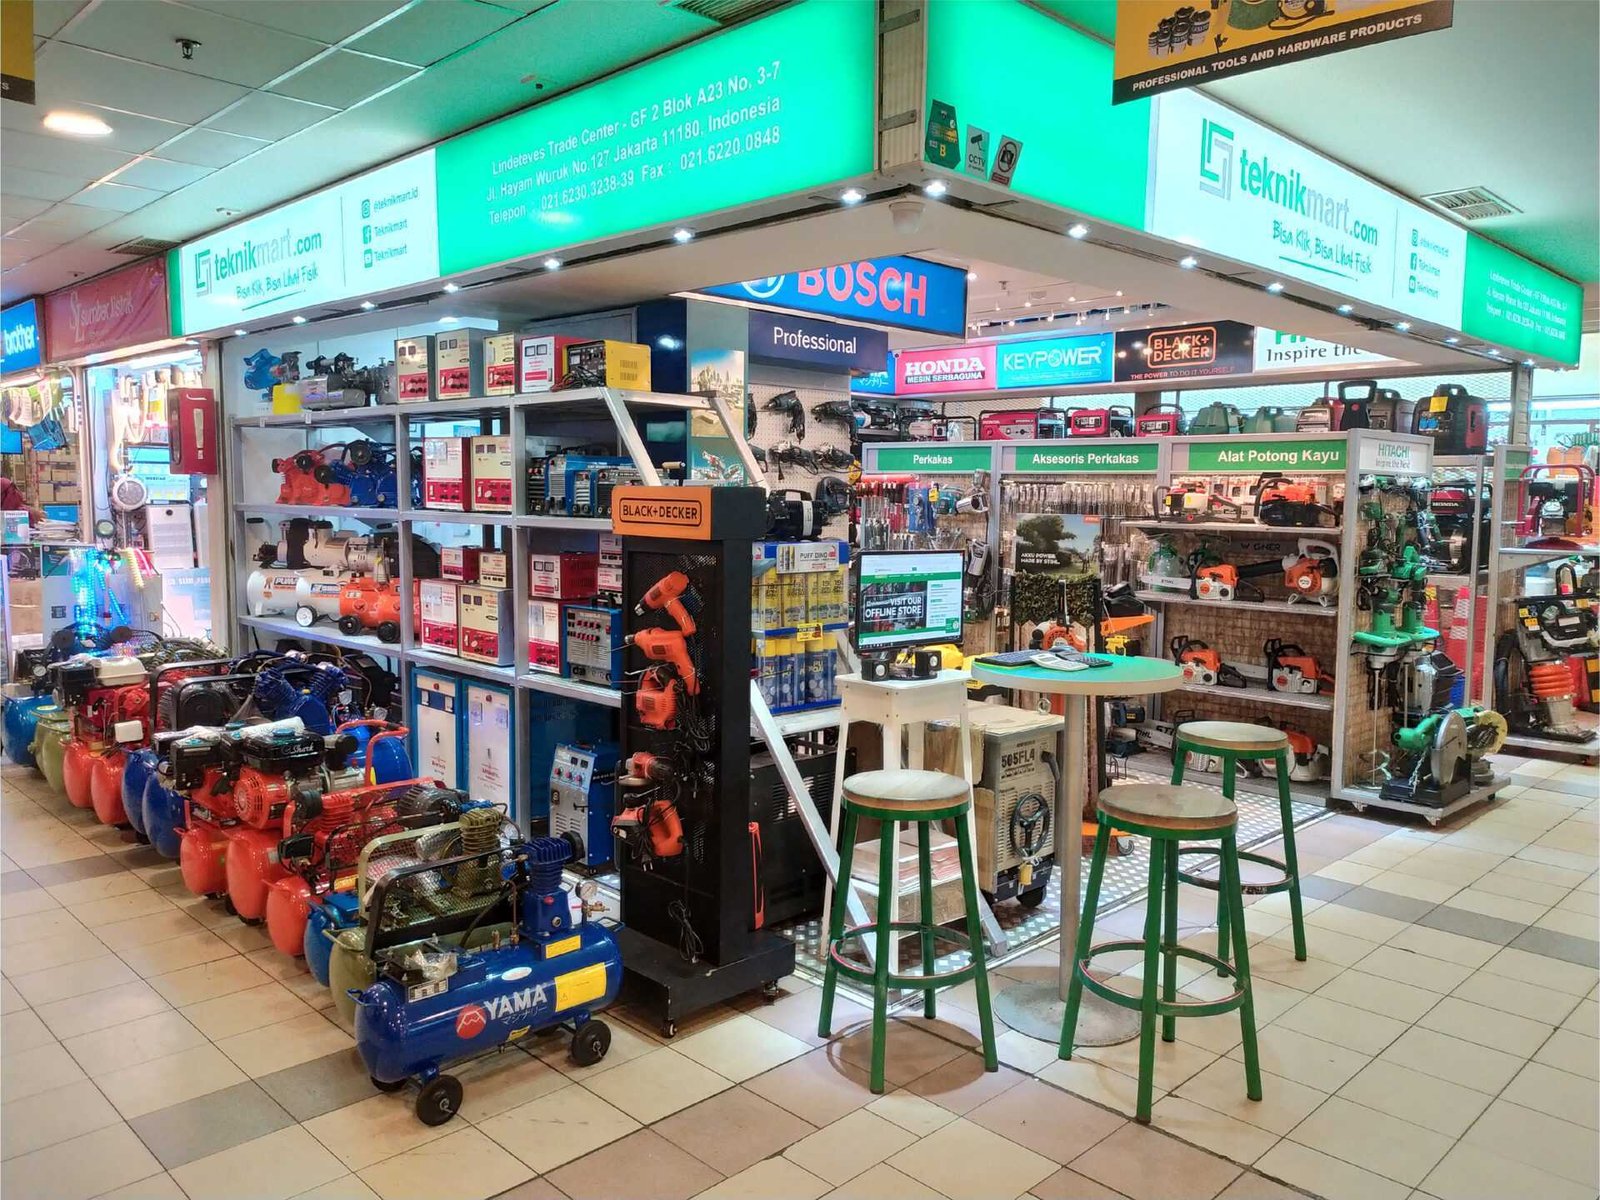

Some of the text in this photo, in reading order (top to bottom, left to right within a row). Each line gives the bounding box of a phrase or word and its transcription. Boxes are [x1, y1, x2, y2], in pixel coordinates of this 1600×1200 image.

[1132, 14, 1422, 91] PROFESSIONAL TOOLS AND HARDWARE PRODUCTS
[492, 147, 545, 175] Lindeteves
[547, 136, 578, 157] Trade
[581, 122, 619, 145] Center
[630, 108, 647, 128] GF
[651, 105, 659, 121] 2
[663, 93, 693, 117] Blok
[697, 81, 723, 105] A23
[728, 75, 752, 95] No.
[757, 61, 780, 85] 3-7
[501, 176, 533, 198] Hayam
[536, 165, 569, 186] Wuruk
[614, 136, 658, 162] Jakarta
[708, 97, 780, 132] Indonesia
[968, 153, 986, 168] CCTV
[489, 203, 526, 224] Telepon
[641, 163, 664, 181] Fax
[680, 126, 780, 170] 021.6220.0848
[1240, 149, 1378, 246] teknikmart.com
[1273, 219, 1293, 245] Bisa
[1315, 237, 1334, 260] Bisa
[214, 228, 322, 281] teknikmart.com
[797, 261, 928, 317] BOSCH
[4, 323, 35, 356] brother
[773, 326, 857, 355] Professional
[1153, 334, 1210, 351] BLACK+
[1003, 345, 1102, 371] KEYPOWER
[1153, 347, 1209, 362] DECKER
[1267, 346, 1327, 363] Inspire
[905, 356, 986, 377] HONDA
[1144, 371, 1168, 379] POWER
[907, 370, 983, 384] MESIN SERBAGUNA
[913, 454, 953, 465] Perkakas
[1032, 452, 1139, 465] Aksesoris Perkakas
[1218, 448, 1340, 464] Alat Potong Kayu
[1377, 442, 1410, 459] HITACHI
[622, 504, 698, 520] BLACK+DECKER
[890, 597, 907, 606] VISIT
[907, 596, 922, 605] OUR
[865, 605, 922, 618] OFFLINE STORE
[483, 984, 548, 1021] YAMA
